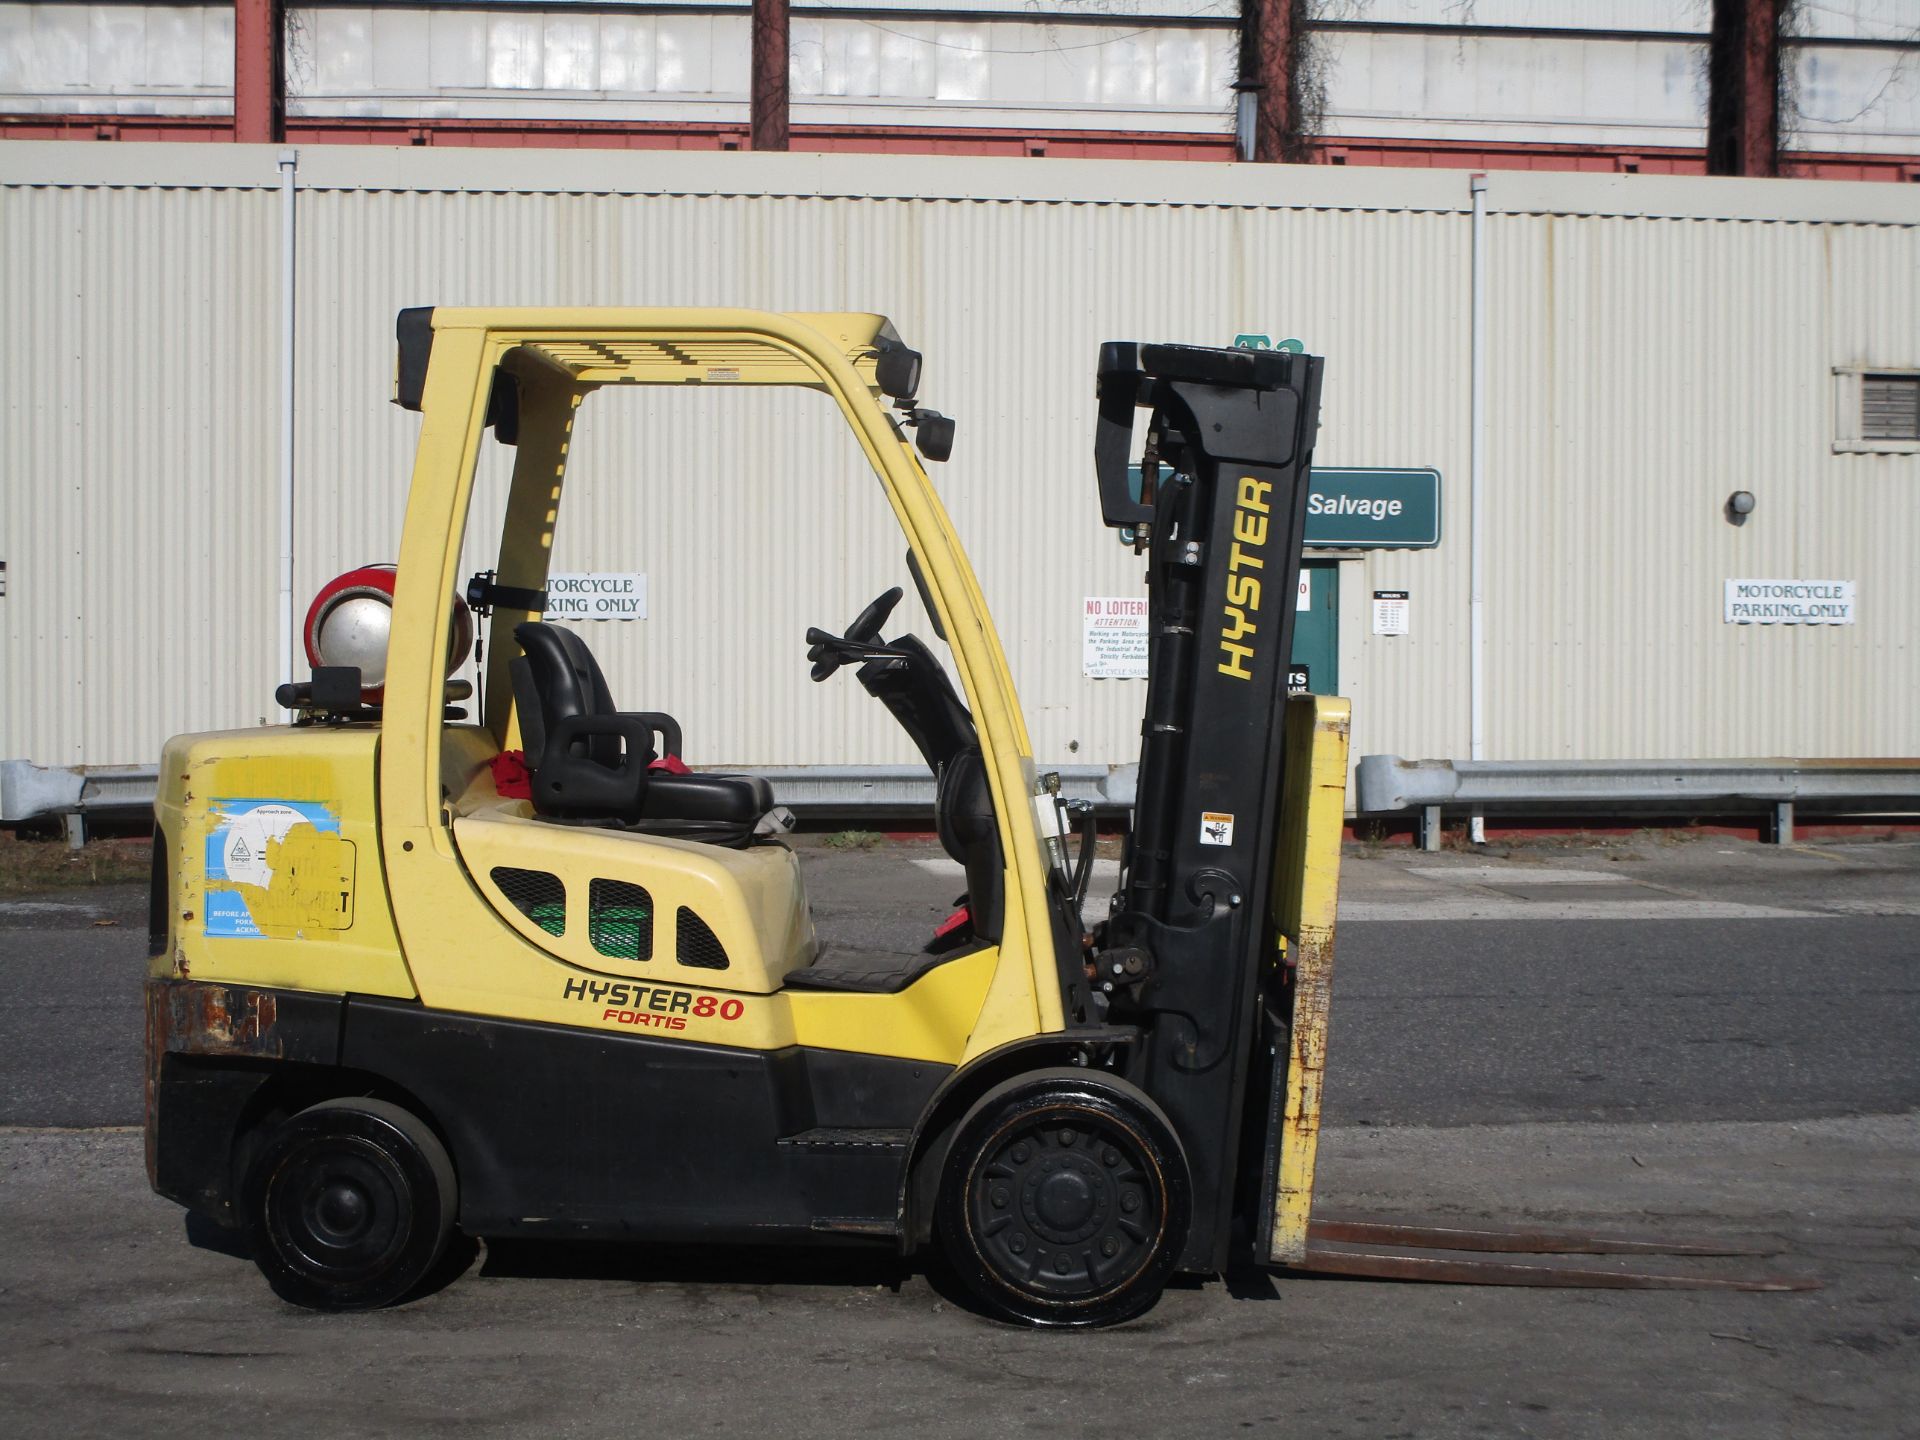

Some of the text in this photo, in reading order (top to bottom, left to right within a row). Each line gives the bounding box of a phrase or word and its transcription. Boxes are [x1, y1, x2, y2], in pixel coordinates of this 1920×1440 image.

[1307, 493, 1403, 521] Salvage
[546, 579, 634, 593] TORCYCLE
[1218, 477, 1273, 680] HYSTER
[1736, 585, 1843, 599] MOTORCYCLE
[546, 598, 641, 612] KING ONLY
[1086, 600, 1148, 616] NO LOITERI
[1731, 603, 1849, 618] PARKING ONLY
[1288, 672, 1307, 685] TS
[562, 977, 745, 1021] HYSTER 80
[602, 1008, 688, 1031] FORTIS
